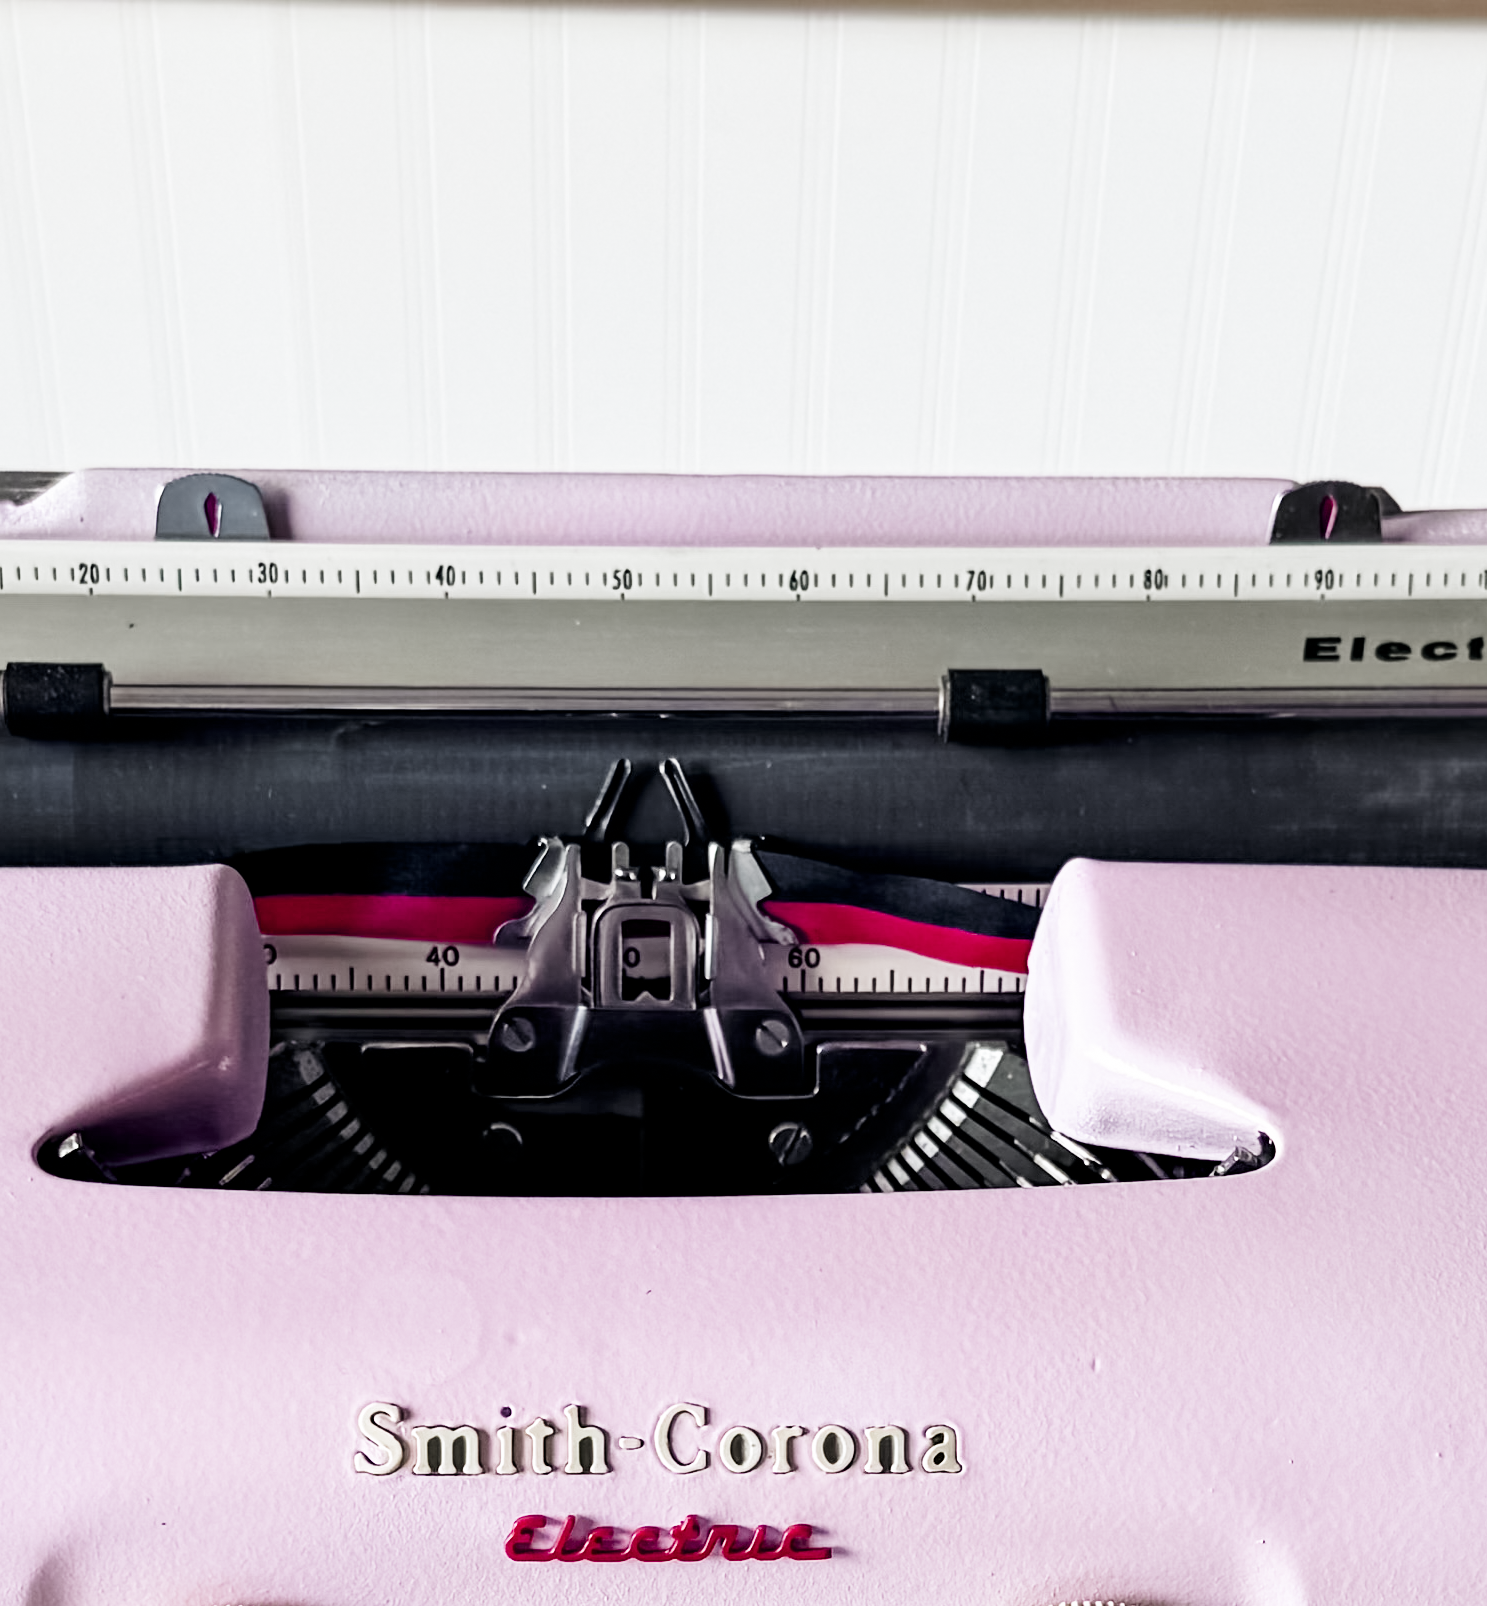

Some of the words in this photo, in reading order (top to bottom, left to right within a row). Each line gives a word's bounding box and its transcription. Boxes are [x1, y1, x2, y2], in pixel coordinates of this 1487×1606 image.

[78, 563, 100, 585] 20
[257, 562, 279, 584] 30
[435, 565, 456, 586] 40
[612, 569, 633, 590] 50
[788, 570, 810, 591] 60
[966, 570, 987, 591] 70
[1143, 569, 1163, 590] 80
[1314, 569, 1334, 590] 90
[426, 945, 460, 966] 40
[787, 947, 821, 968] 60
[354, 1402, 967, 1476] Smith-Corona
[504, 1514, 833, 1563] Electric
